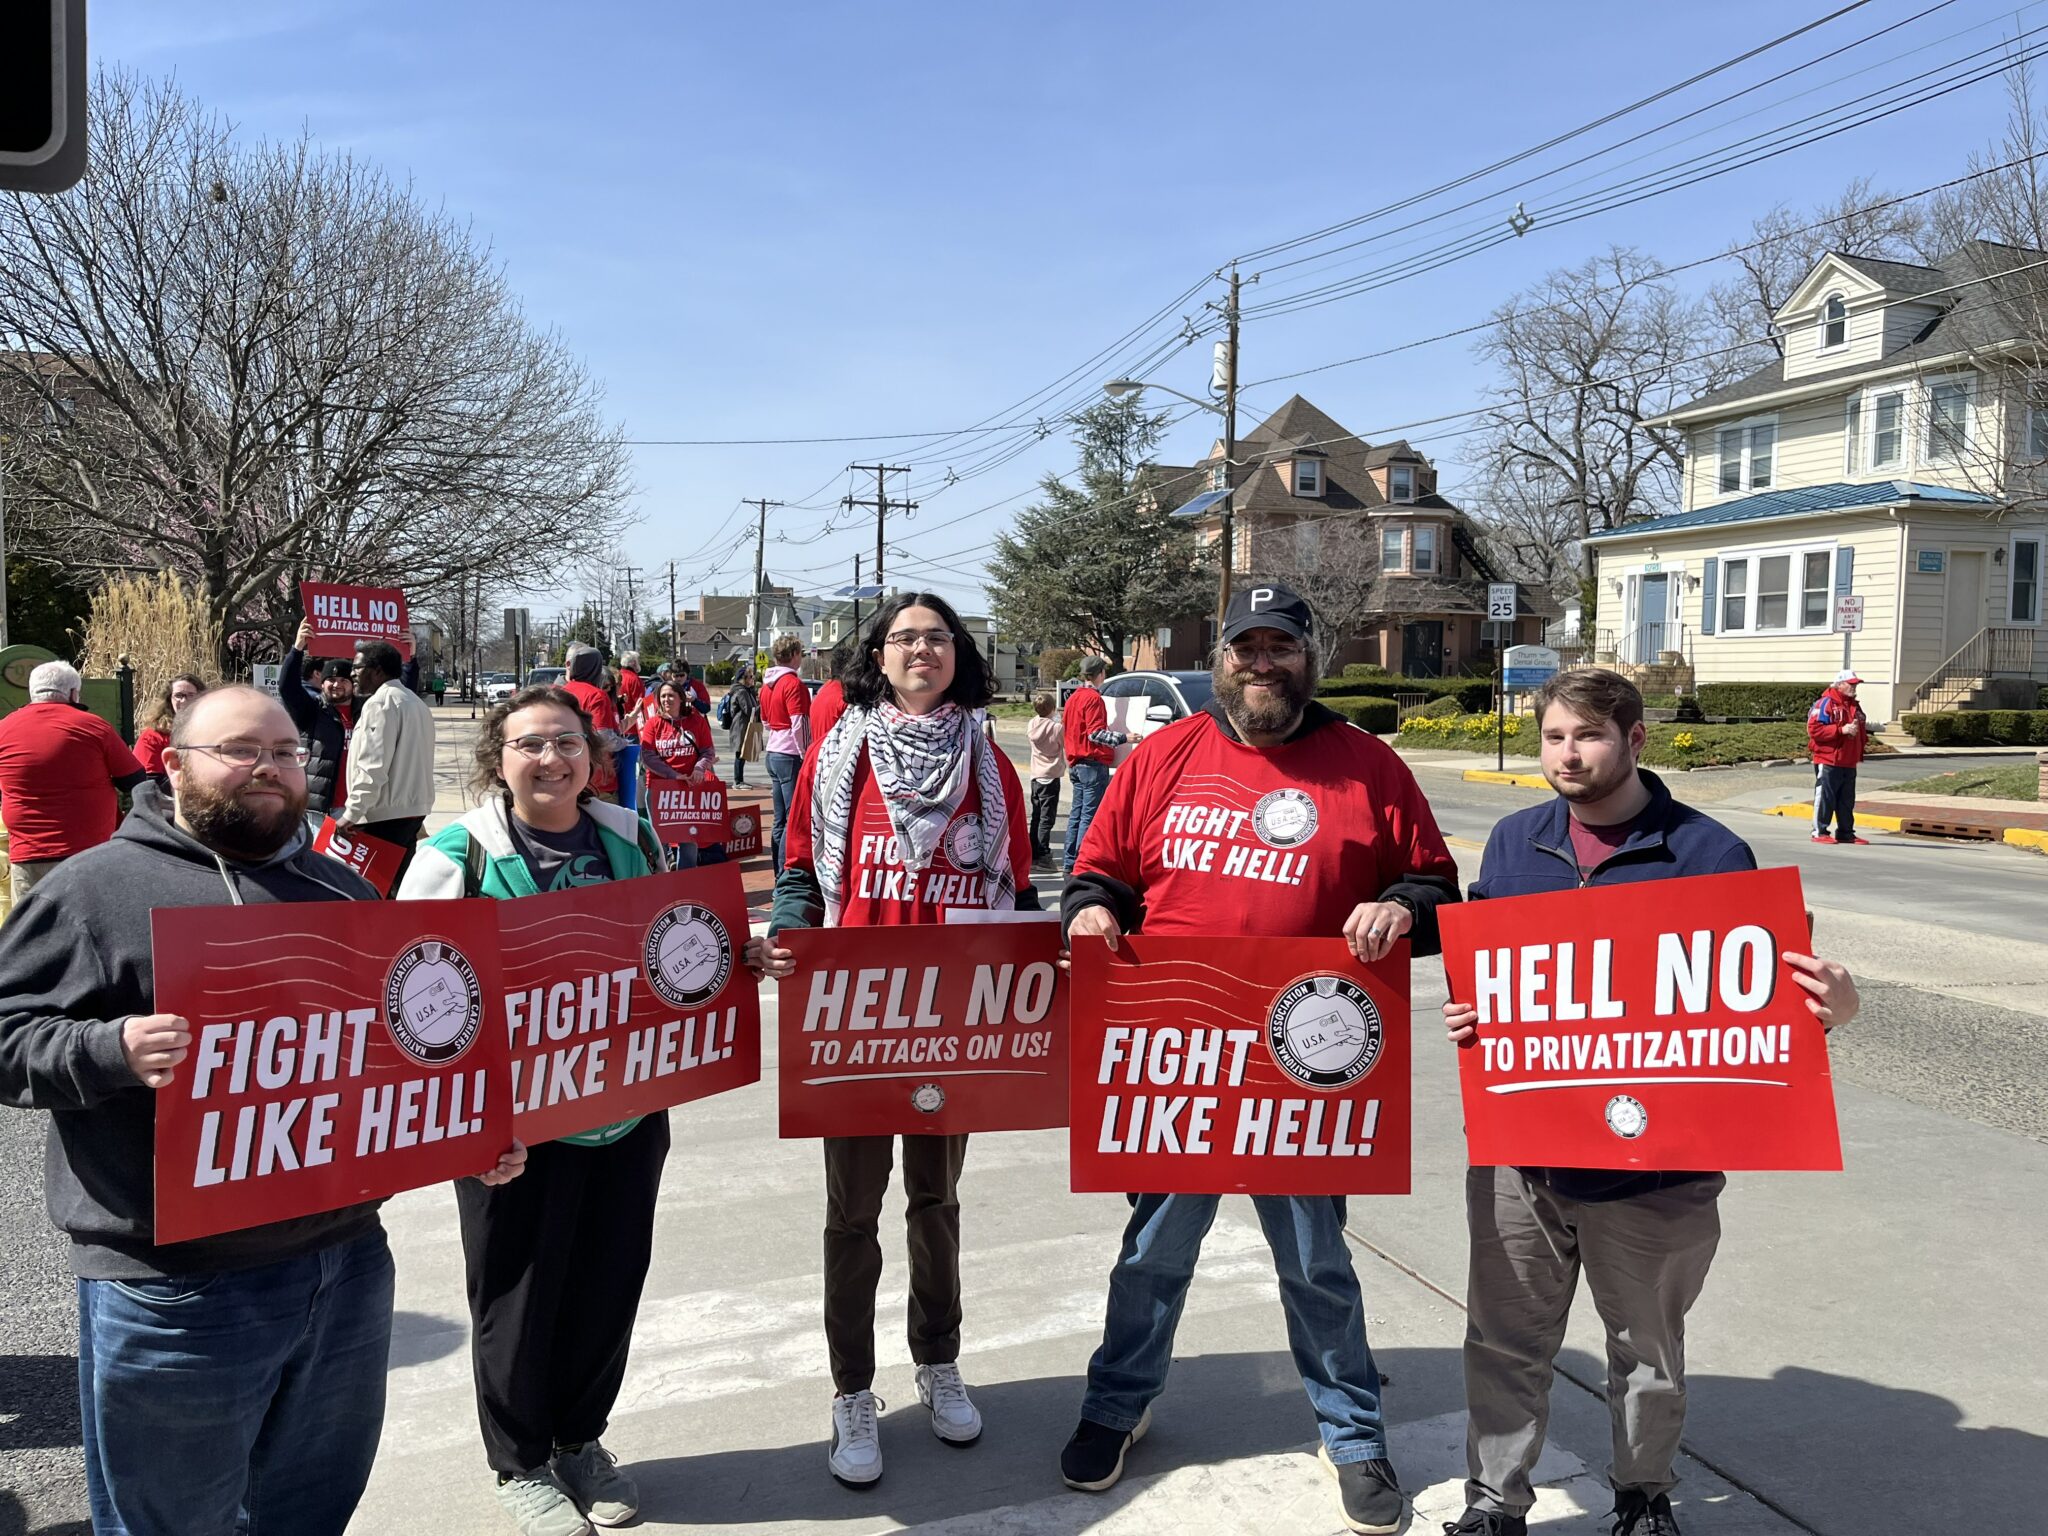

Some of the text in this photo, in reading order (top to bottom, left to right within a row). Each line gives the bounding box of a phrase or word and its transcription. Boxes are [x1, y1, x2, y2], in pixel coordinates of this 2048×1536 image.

[313, 594, 398, 622] HELL NO
[1250, 588, 1274, 612] P
[1491, 587, 1514, 595] SPEED
[1844, 598, 1856, 606] NO
[317, 618, 401, 635] TO ATTACKS ON US!
[1491, 603, 1513, 616] 25
[656, 739, 678, 749] FIGHT
[658, 748, 673, 757] IKE
[657, 790, 722, 810] HELL NO
[659, 811, 723, 820] TO ATTACKS ON US!
[1162, 805, 1249, 840] FIGHT
[352, 842, 369, 863] US!
[725, 836, 756, 854] HELL!
[1161, 838, 1310, 886] LIKE HELL!
[858, 868, 986, 905] LIKE HELL!
[648, 910, 729, 1002] NATIONAL ASSOCIATION OF LETTER CARRIERS
[1474, 924, 1775, 1024] HELL NO
[389, 951, 479, 1057] NATIONAL ASSOCIATION OF LETTER CARRIERS
[504, 966, 639, 1050] FIGHT
[802, 961, 1056, 1032] HELL NO
[809, 1030, 1053, 1065] TO ATTACKS ON US!
[1272, 984, 1379, 1080] NATIONAL ASSOCIATION OF LETTER CARRIERS
[1479, 1024, 1791, 1072] TO PRIVATIZATION!
[191, 1007, 377, 1100] FIGHT
[510, 1006, 738, 1115] LIKE HELL!
[1097, 1027, 1260, 1086] FIGHT
[192, 1069, 487, 1189] LIKE HELL!
[1097, 1095, 1381, 1157] LIKE HELL!
